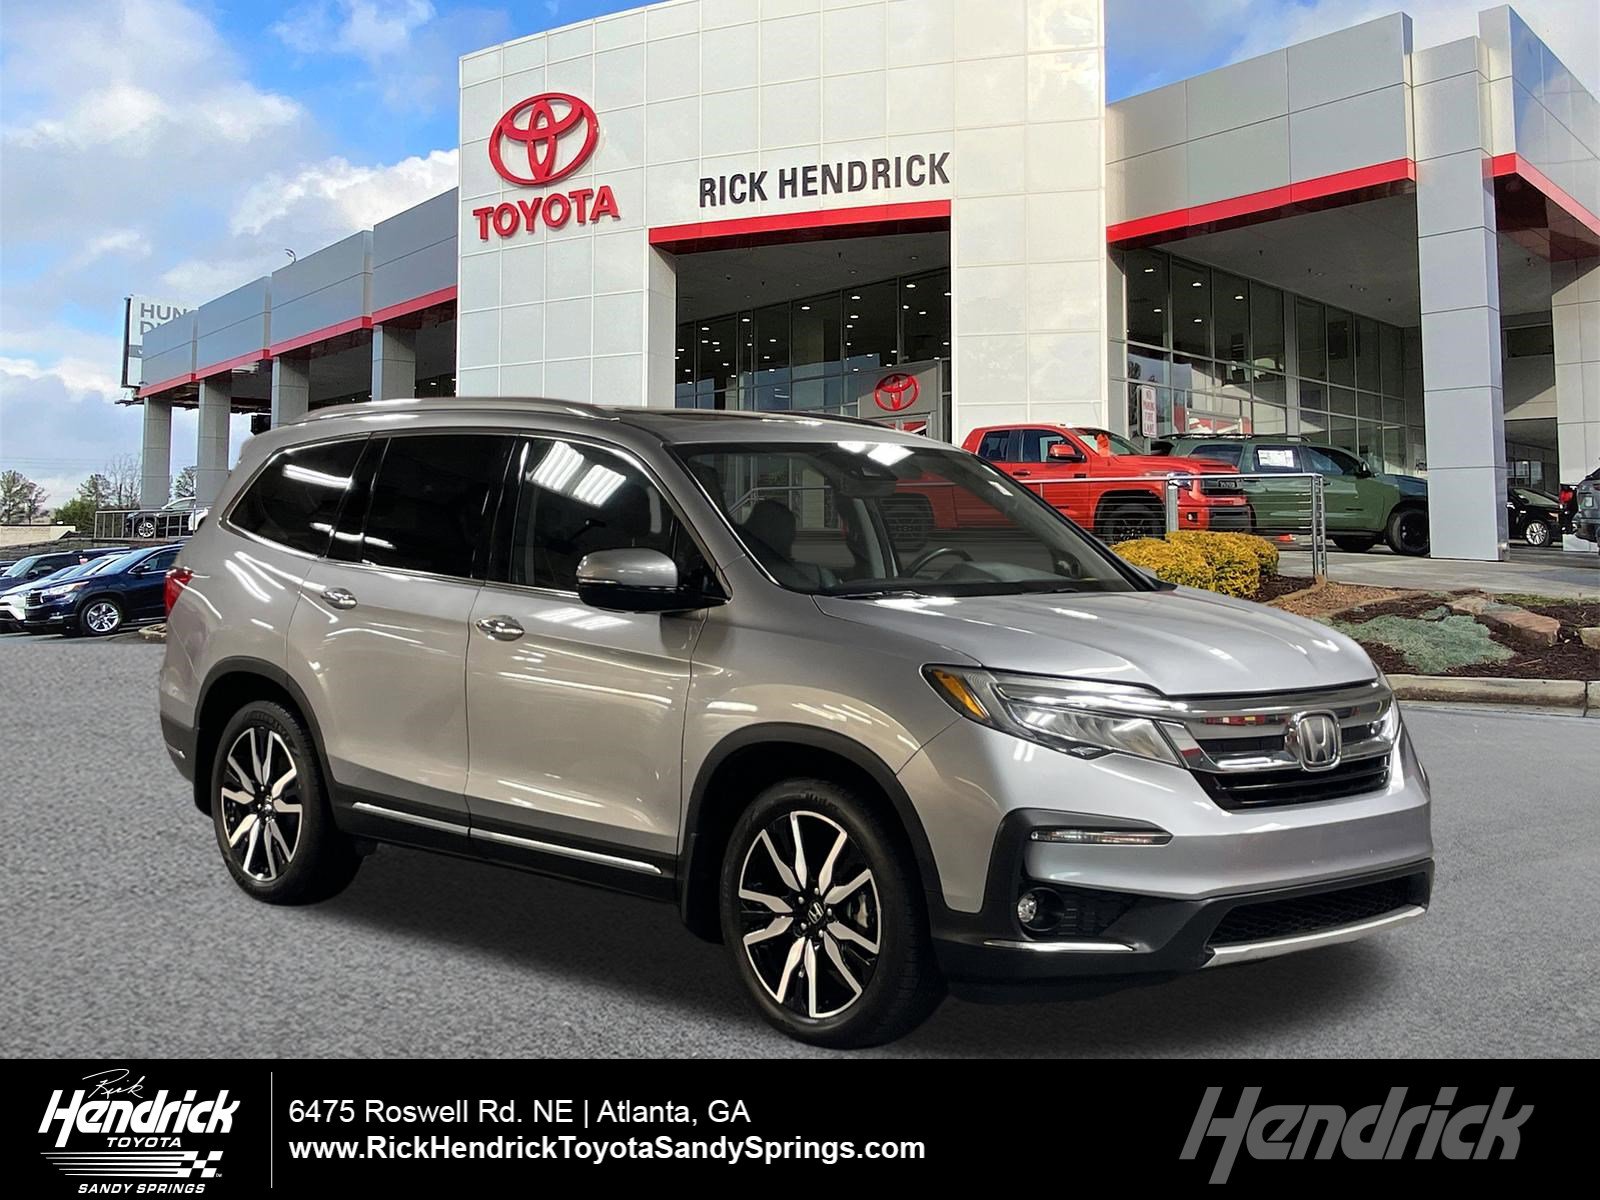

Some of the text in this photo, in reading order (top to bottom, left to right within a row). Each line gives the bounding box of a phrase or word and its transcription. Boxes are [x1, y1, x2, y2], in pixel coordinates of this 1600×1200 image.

[699, 152, 951, 208] RICK HENDRICK
[472, 185, 621, 241] TOYOTA
